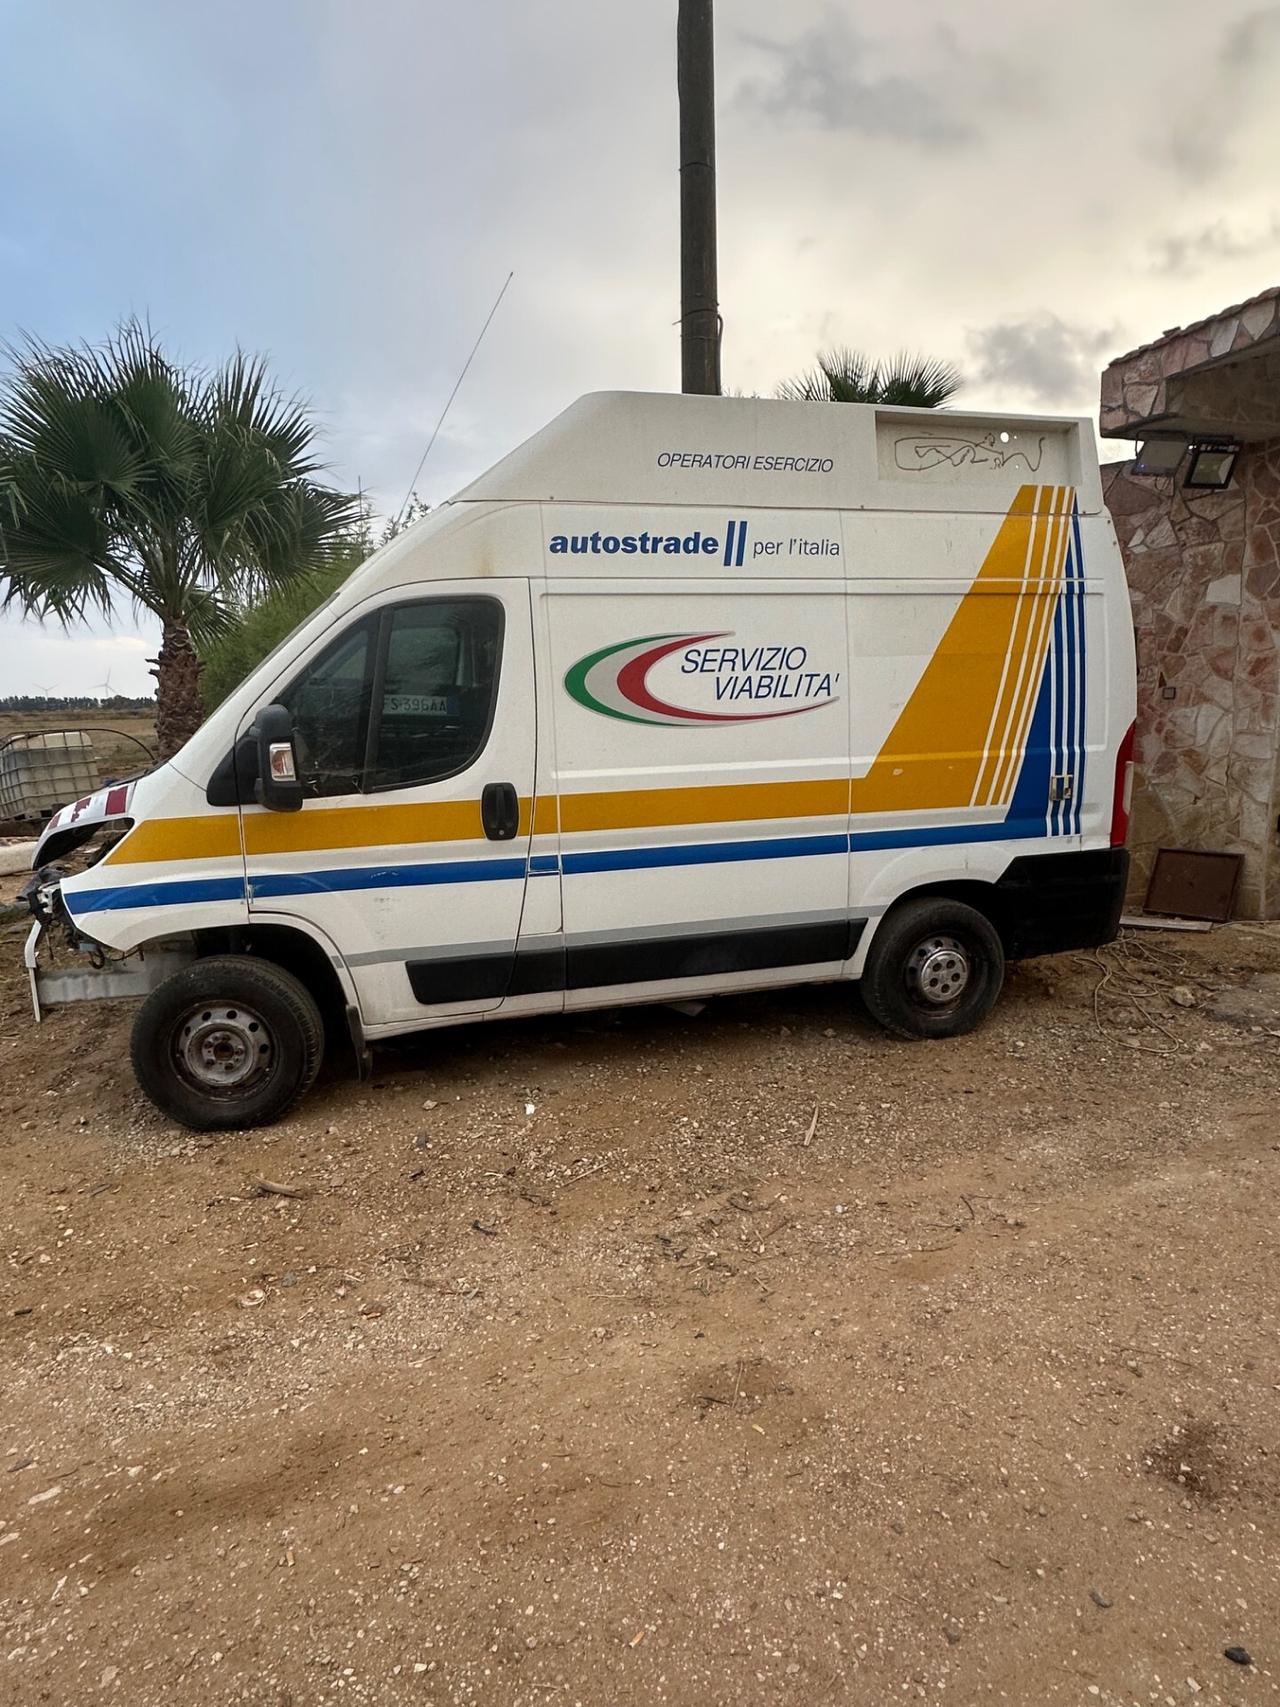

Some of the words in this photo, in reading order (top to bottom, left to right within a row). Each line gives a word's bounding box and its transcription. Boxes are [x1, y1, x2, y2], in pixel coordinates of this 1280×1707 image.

[657, 452, 750, 470] OPERATORI
[753, 456, 834, 473] ESERCIZIO
[549, 531, 719, 555] autostrade
[753, 540, 783, 559] per
[681, 647, 806, 673] SERVIZIO
